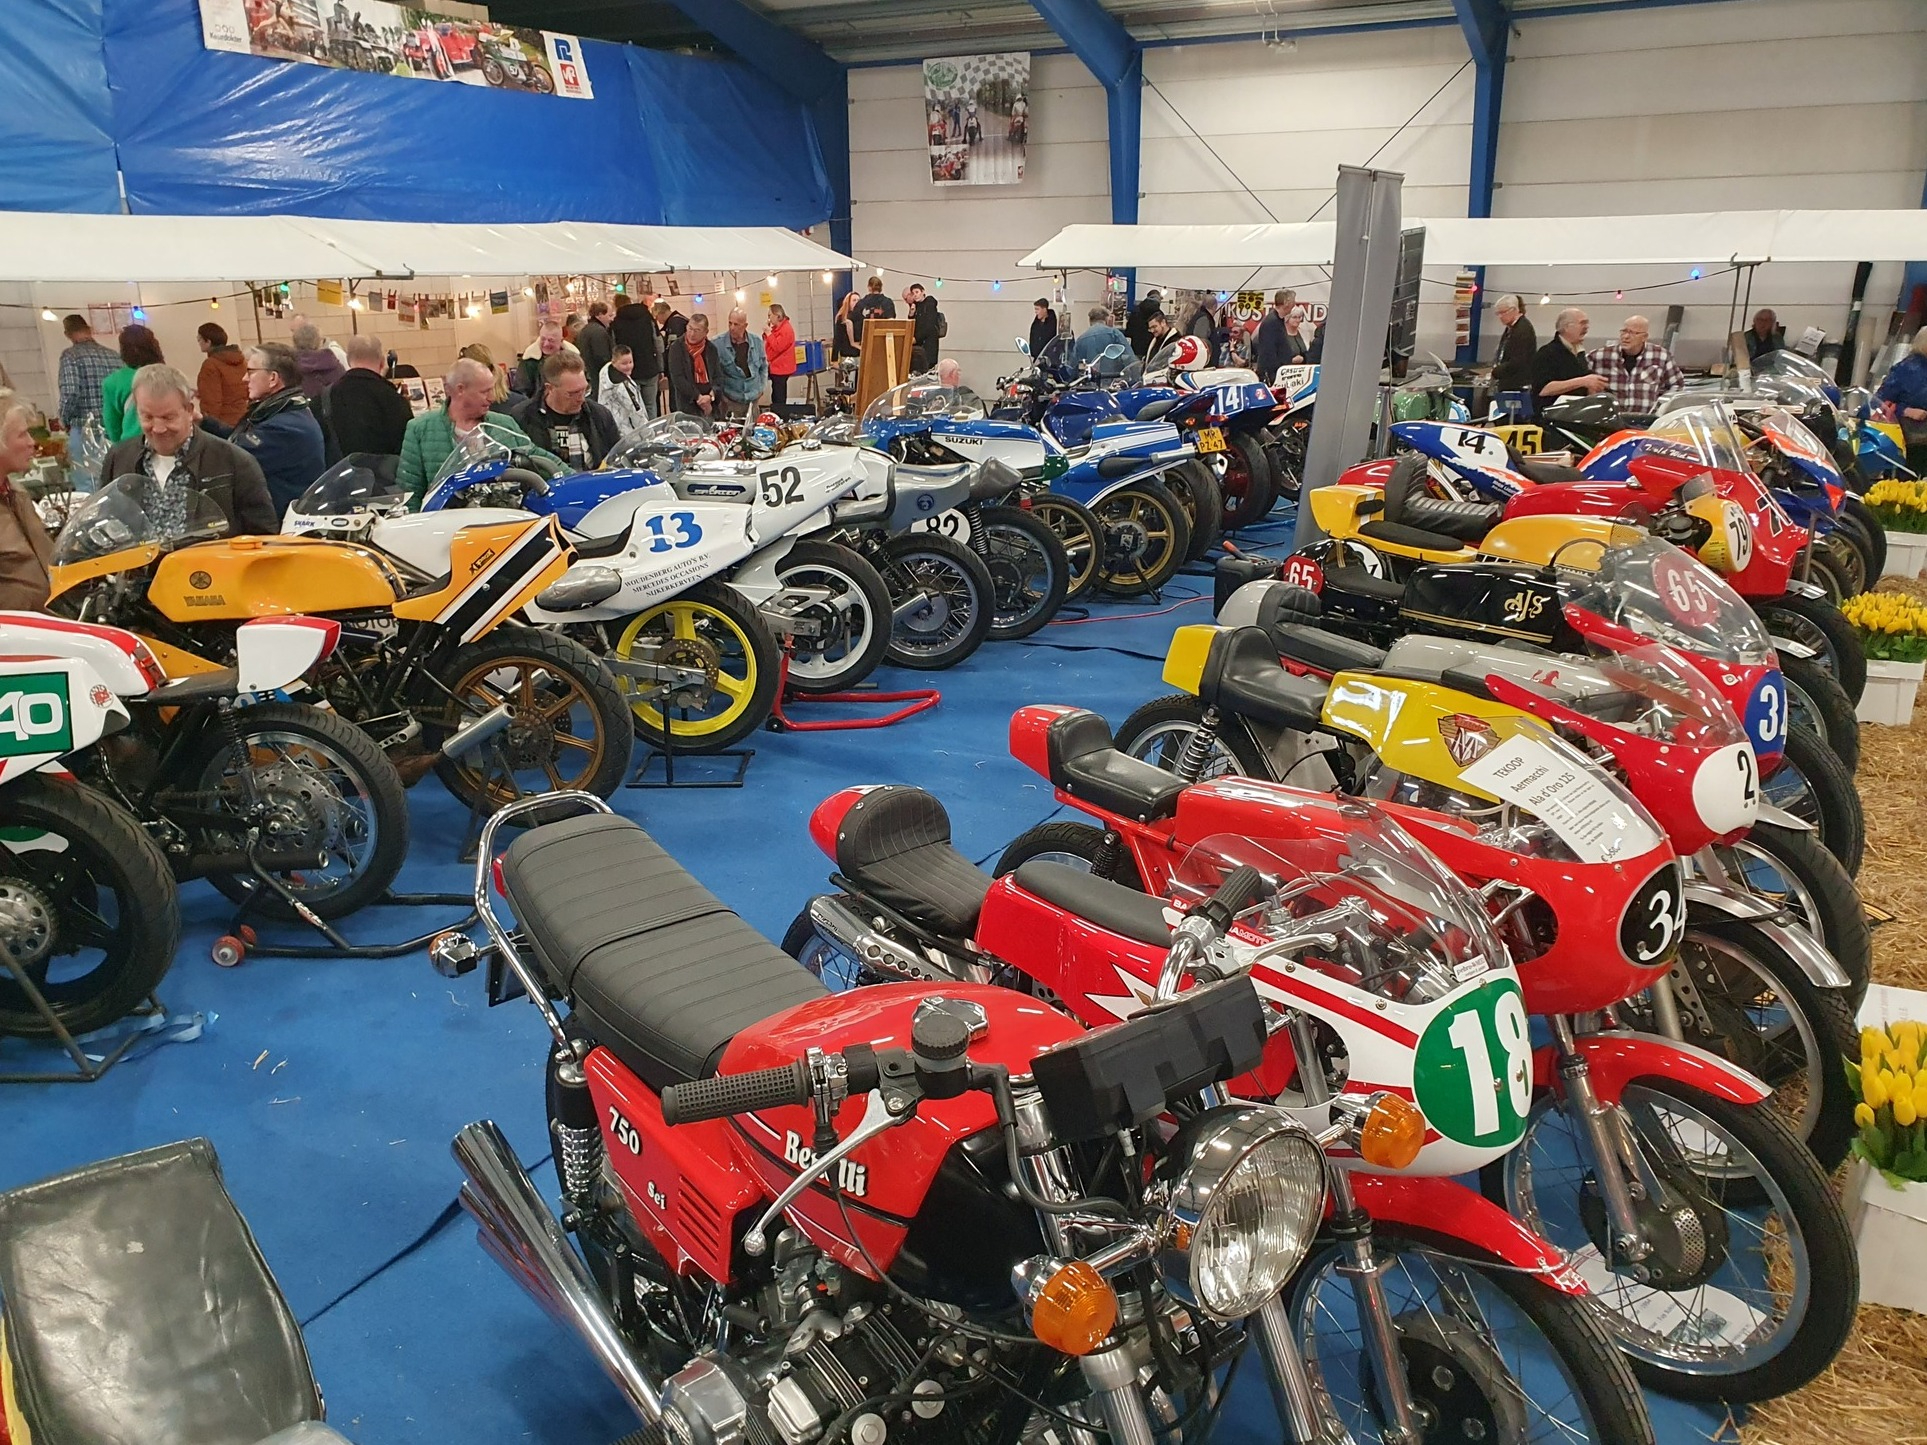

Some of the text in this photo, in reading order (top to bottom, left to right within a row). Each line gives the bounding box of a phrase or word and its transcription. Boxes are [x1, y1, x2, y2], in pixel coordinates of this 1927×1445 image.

[945, 437, 983, 446] SUZUKI
[1457, 431, 1486, 454] 14
[759, 466, 804, 508] 52
[645, 512, 703, 553] 13
[624, 567, 673, 587] WOUDENBERG
[632, 563, 710, 594] MERCEDES OCCASIONS
[1289, 561, 1315, 590] 65
[1667, 568, 1708, 612] 65
[0, 691, 63, 741] 40
[1493, 756, 1525, 779] TEKOOP
[1510, 765, 1550, 793] Aermacchi
[1737, 749, 1755, 800] 2
[1528, 793, 1545, 807] Ala
[1561, 772, 1576, 786] 125
[1447, 991, 1534, 1137] 18
[608, 1105, 641, 1155] 750
[784, 1129, 868, 1198] Belli
[647, 1181, 668, 1211] Sei
